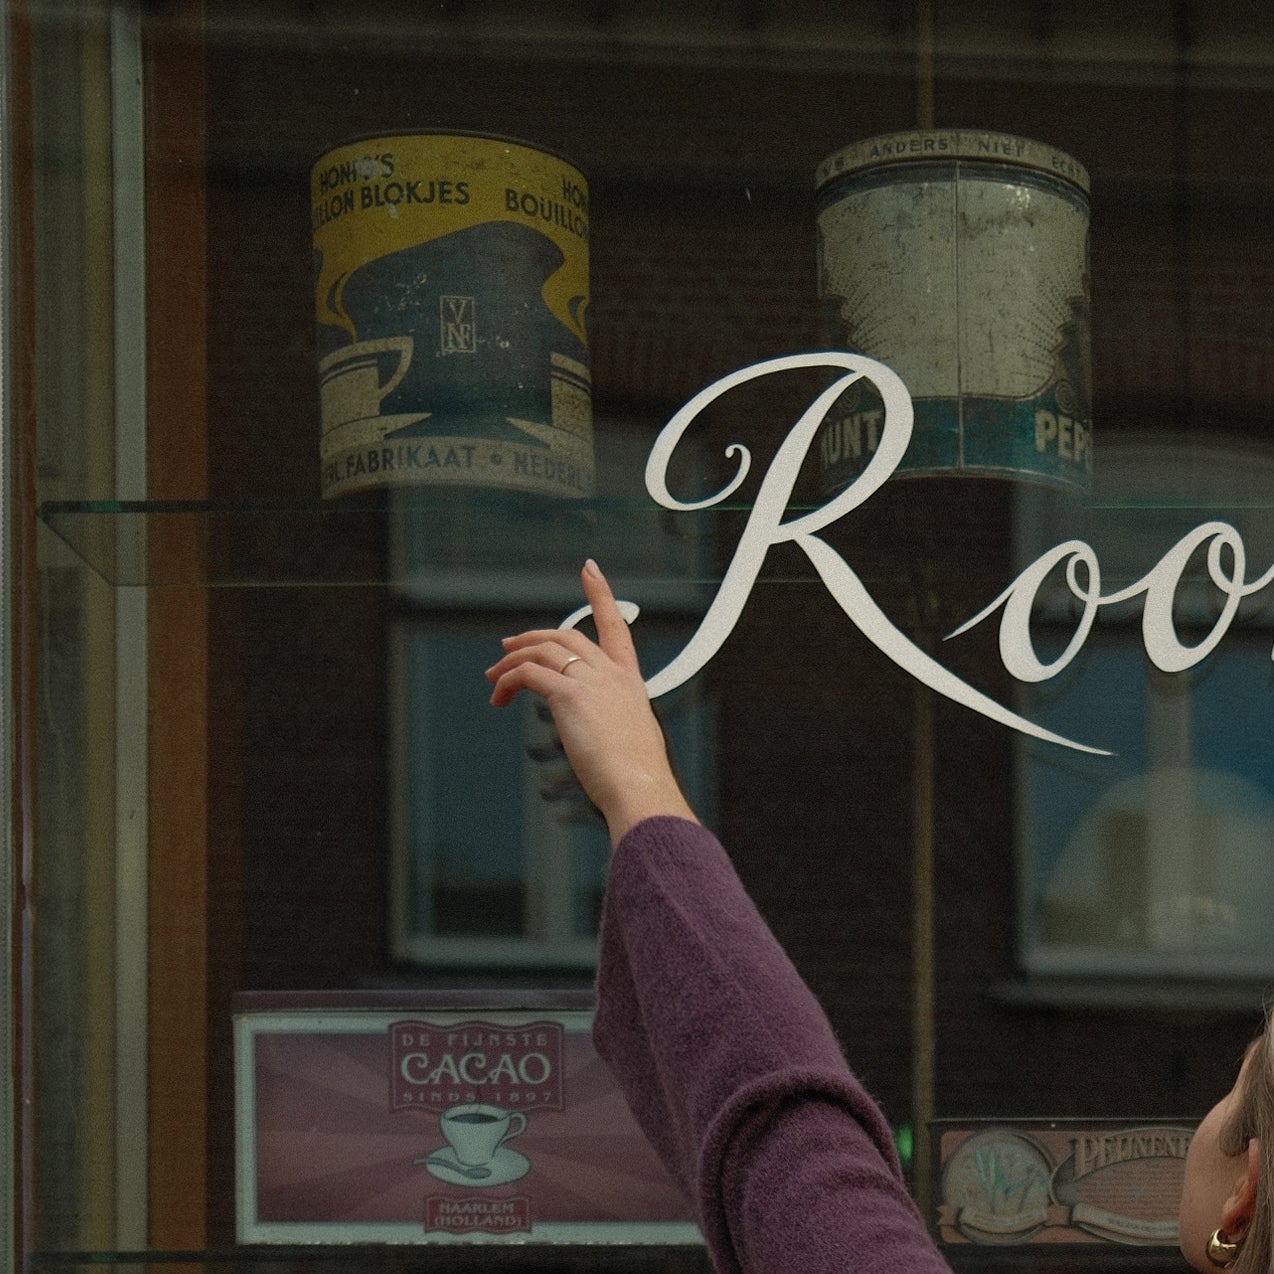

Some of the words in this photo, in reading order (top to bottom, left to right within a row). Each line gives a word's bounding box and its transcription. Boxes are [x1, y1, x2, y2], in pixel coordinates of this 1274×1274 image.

[360, 179, 471, 210] BLOKJES
[402, 1033, 431, 1047] DE
[447, 1033, 549, 1047] FIJNSTE
[400, 1052, 552, 1085] CACAO
